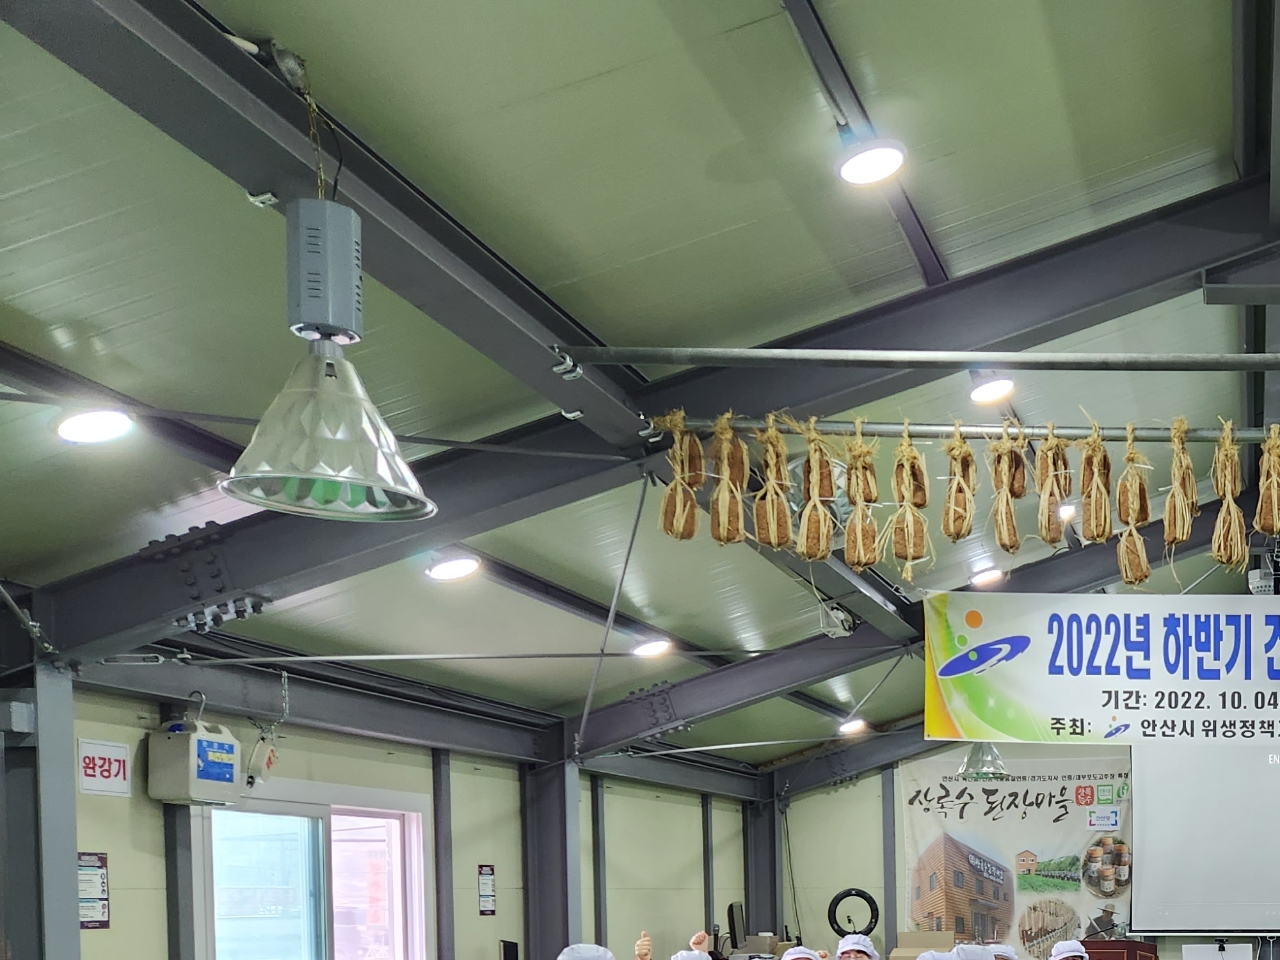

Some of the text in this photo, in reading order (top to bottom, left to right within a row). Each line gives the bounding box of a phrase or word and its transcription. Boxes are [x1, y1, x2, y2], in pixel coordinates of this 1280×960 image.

[1048, 613, 1151, 680] 2022년
[1163, 613, 1252, 680] 하반기
[1101, 690, 1147, 710] 기간:
[1154, 691, 1211, 710] 2022.
[1218, 691, 1247, 710] 10.
[1050, 717, 1092, 737] 주최:
[1140, 719, 1195, 738] 안산시
[82, 755, 127, 781] 완강기
[908, 783, 979, 819] 상록수
[982, 785, 1074, 823] 된장마을
